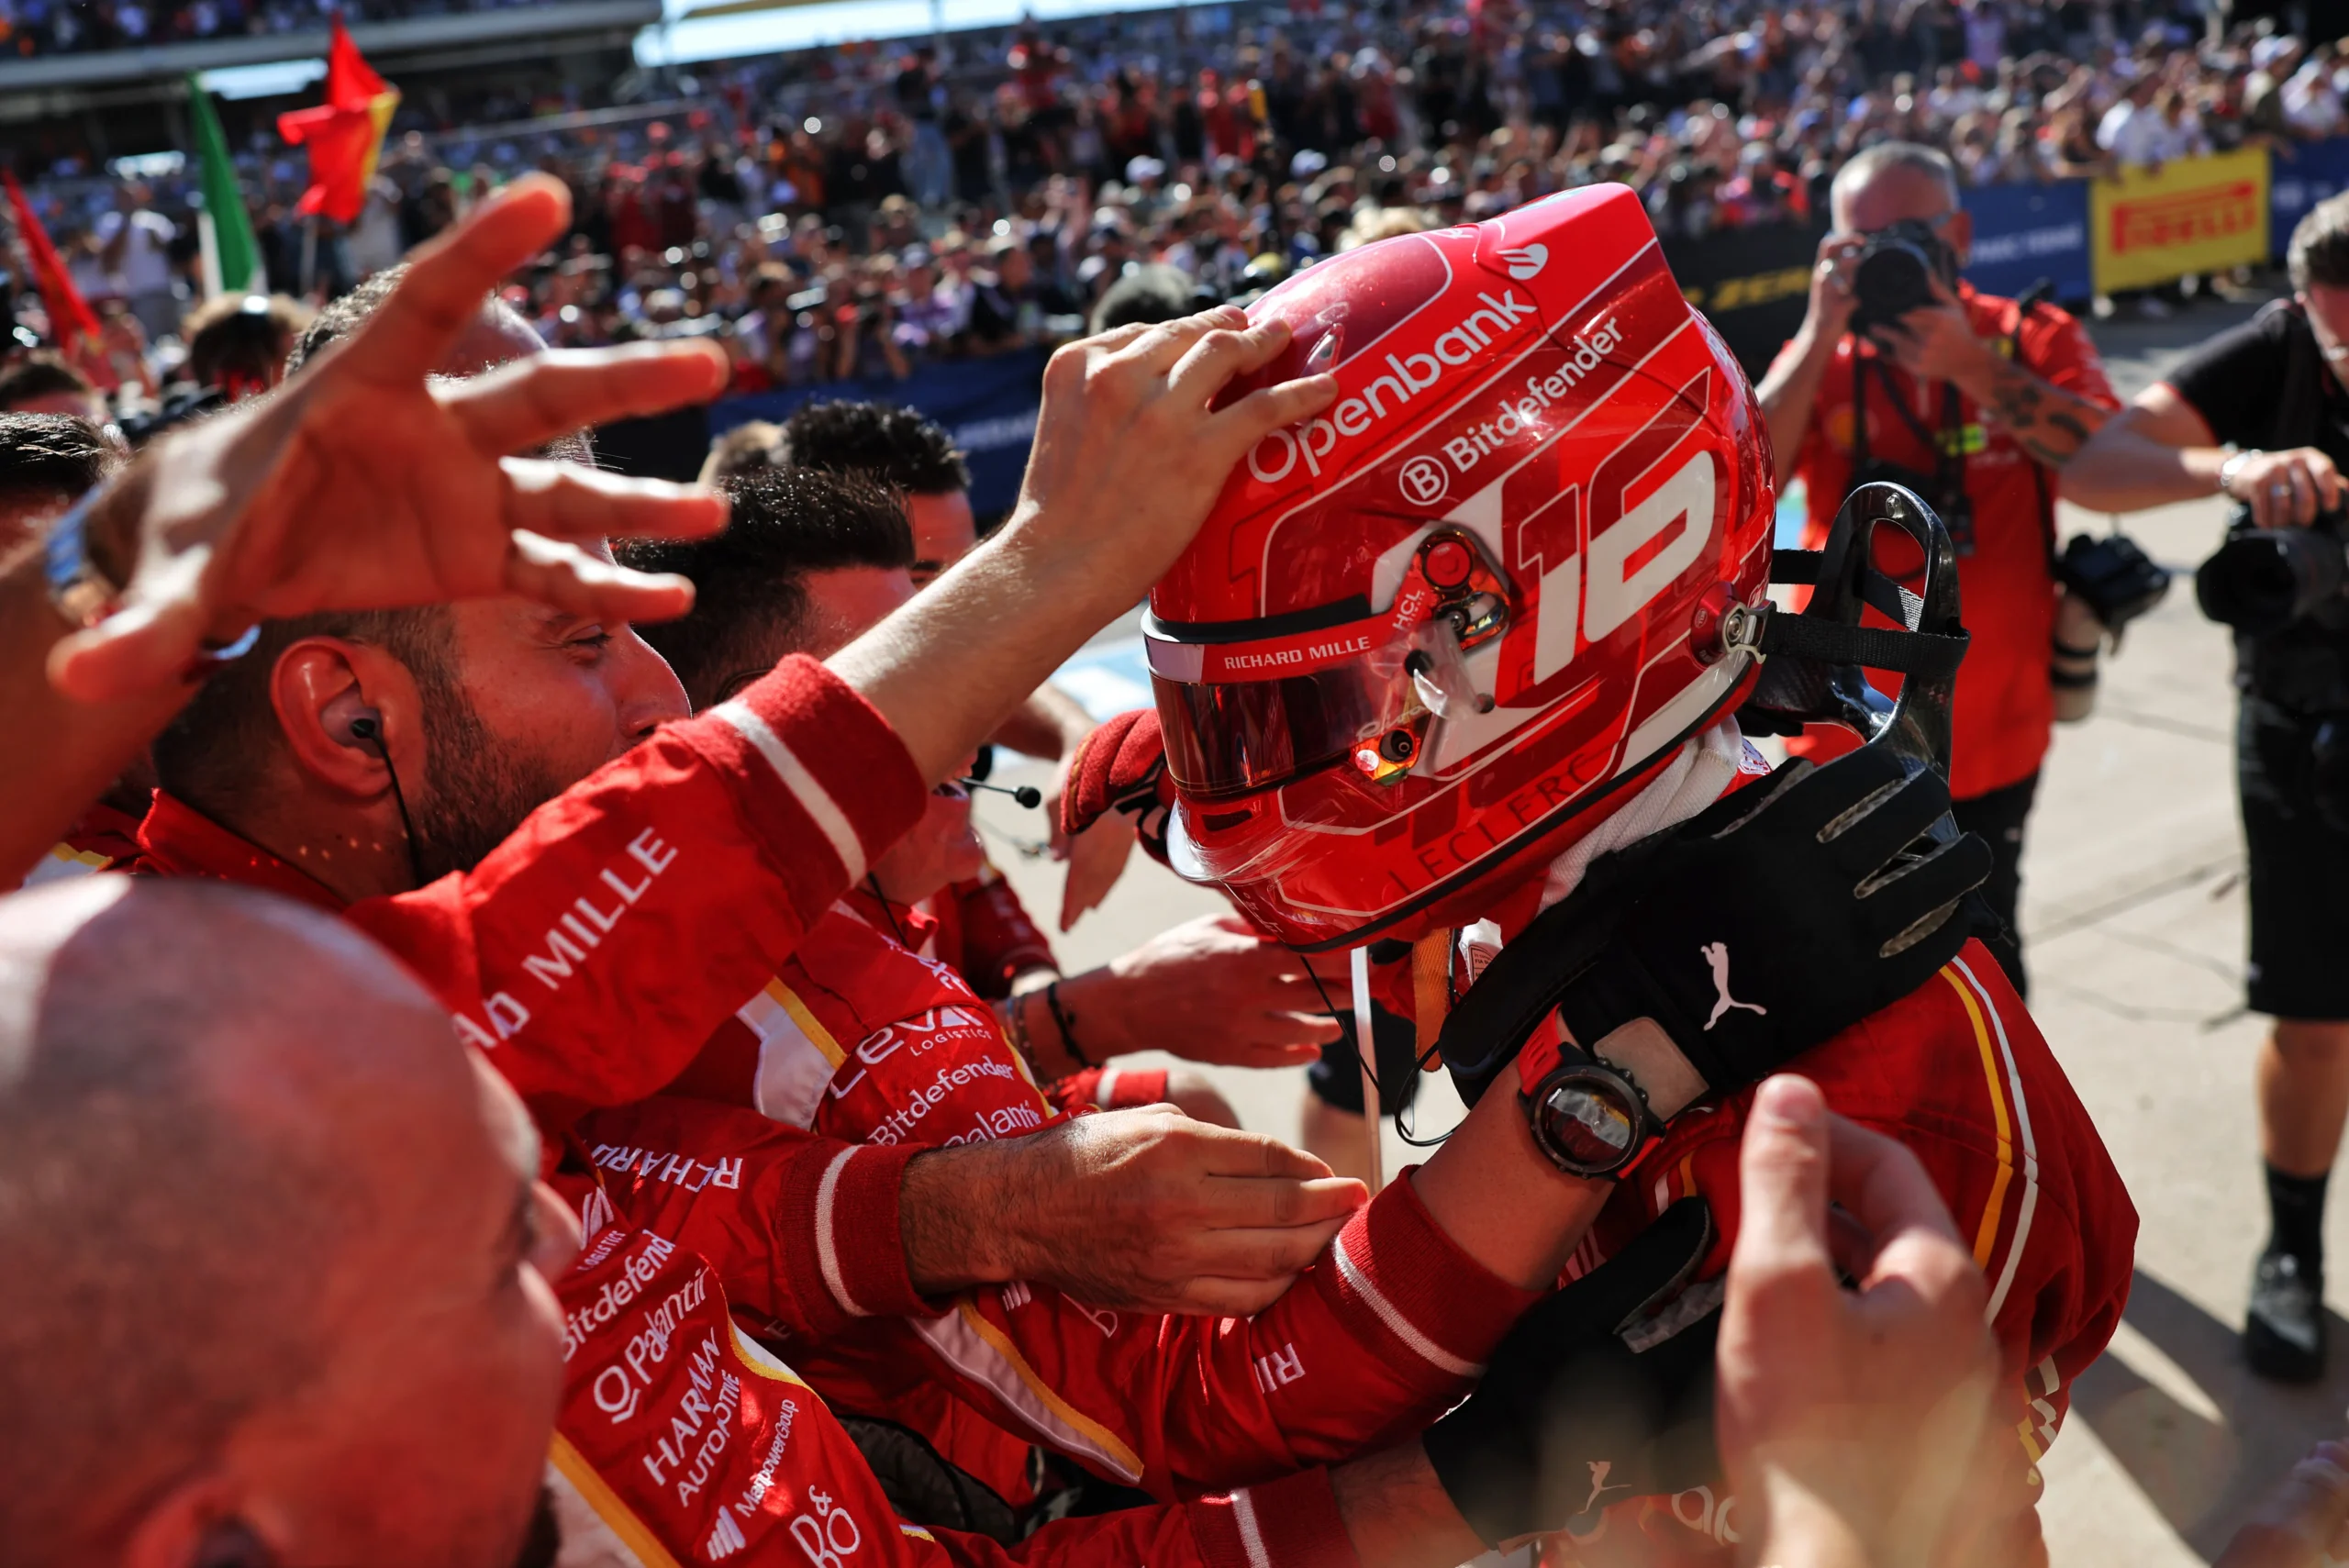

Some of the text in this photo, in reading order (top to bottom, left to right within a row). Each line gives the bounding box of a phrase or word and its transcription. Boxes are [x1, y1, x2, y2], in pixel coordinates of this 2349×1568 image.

[1248, 289, 1538, 484] Openbank
[1442, 317, 1624, 473] Bitdefender
[1224, 636, 1371, 670] RICHARD MILLE
[1392, 589, 1421, 632] HCL
[520, 827, 679, 991] MILLE
[867, 1055, 1015, 1147] Bitdefender
[624, 1266, 710, 1385] Palantir
[735, 1397, 800, 1518] ManpowerGroup
